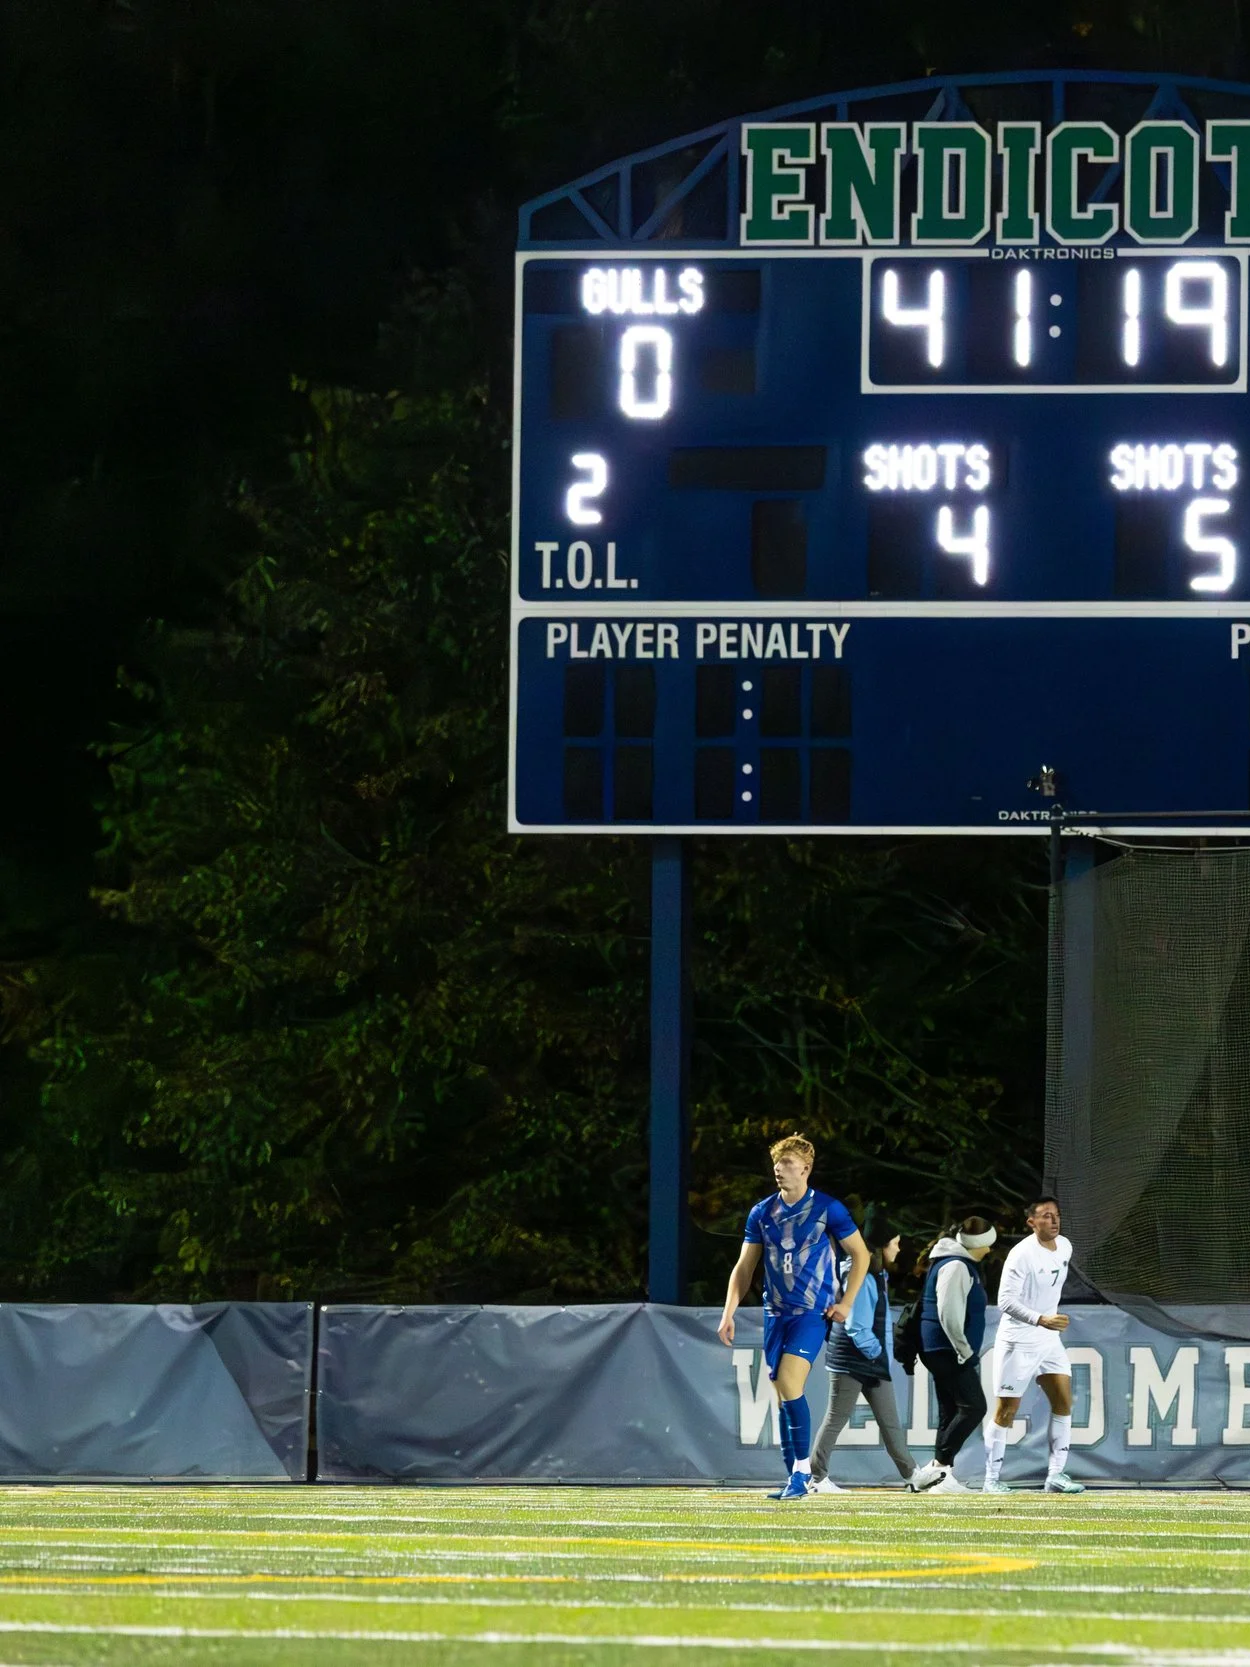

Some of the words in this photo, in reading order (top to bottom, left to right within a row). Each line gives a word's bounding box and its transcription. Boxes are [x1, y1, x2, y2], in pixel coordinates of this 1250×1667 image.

[991, 248, 1115, 260] DAKTRONICS
[582, 267, 704, 314] GULLS
[882, 262, 1229, 369] 41:19
[619, 325, 673, 419] 0
[566, 453, 608, 525] 2
[863, 444, 990, 491] SHOTS
[1110, 443, 1238, 491] SHOTS
[535, 541, 639, 589] T.O.L.
[936, 505, 990, 586] 4
[1183, 497, 1237, 593] 5
[546, 622, 680, 659] PLAYER
[695, 622, 851, 659] PENALTY
[783, 1252, 793, 1274] 8
[1051, 1269, 1060, 1287] 7
